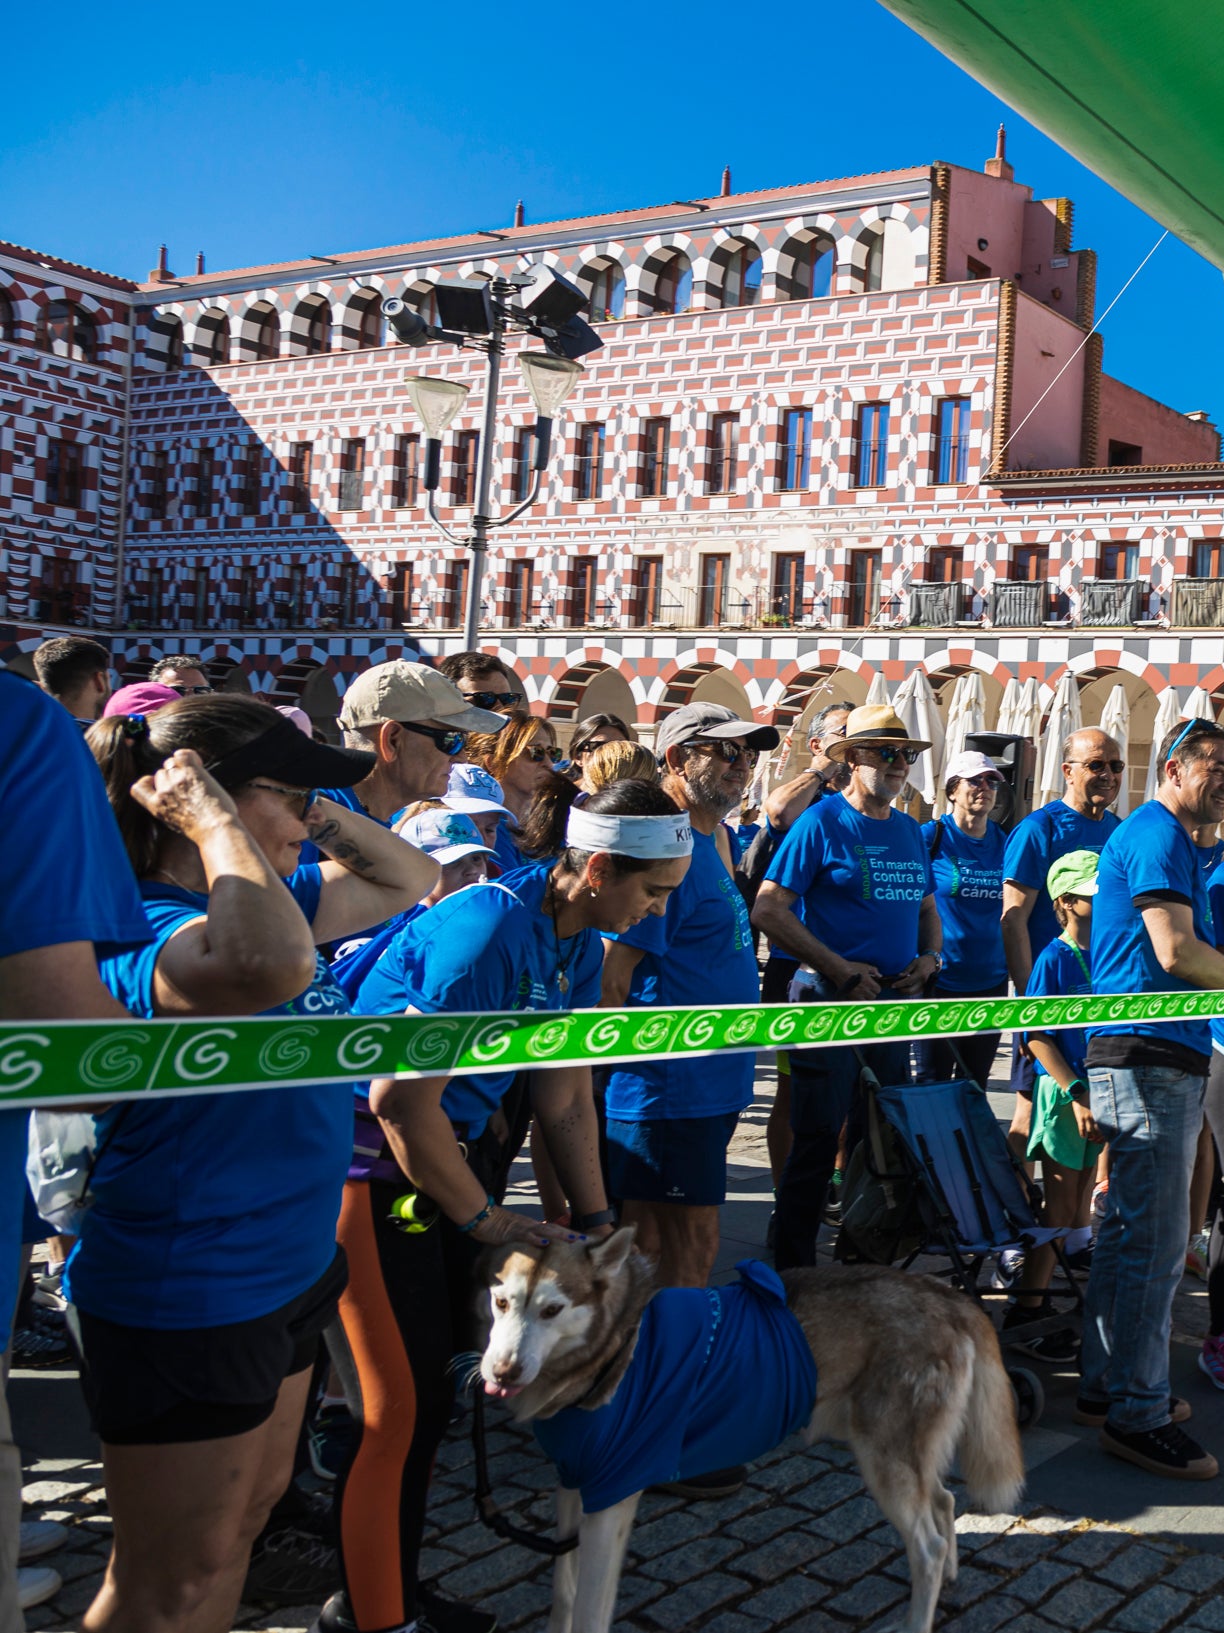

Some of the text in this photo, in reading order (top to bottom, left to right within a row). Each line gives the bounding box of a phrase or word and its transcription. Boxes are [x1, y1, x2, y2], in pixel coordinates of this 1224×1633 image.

[869, 858, 885, 869] En
[873, 871, 915, 883] contra
[961, 876, 1000, 886] contra
[960, 885, 1004, 900] cánce
